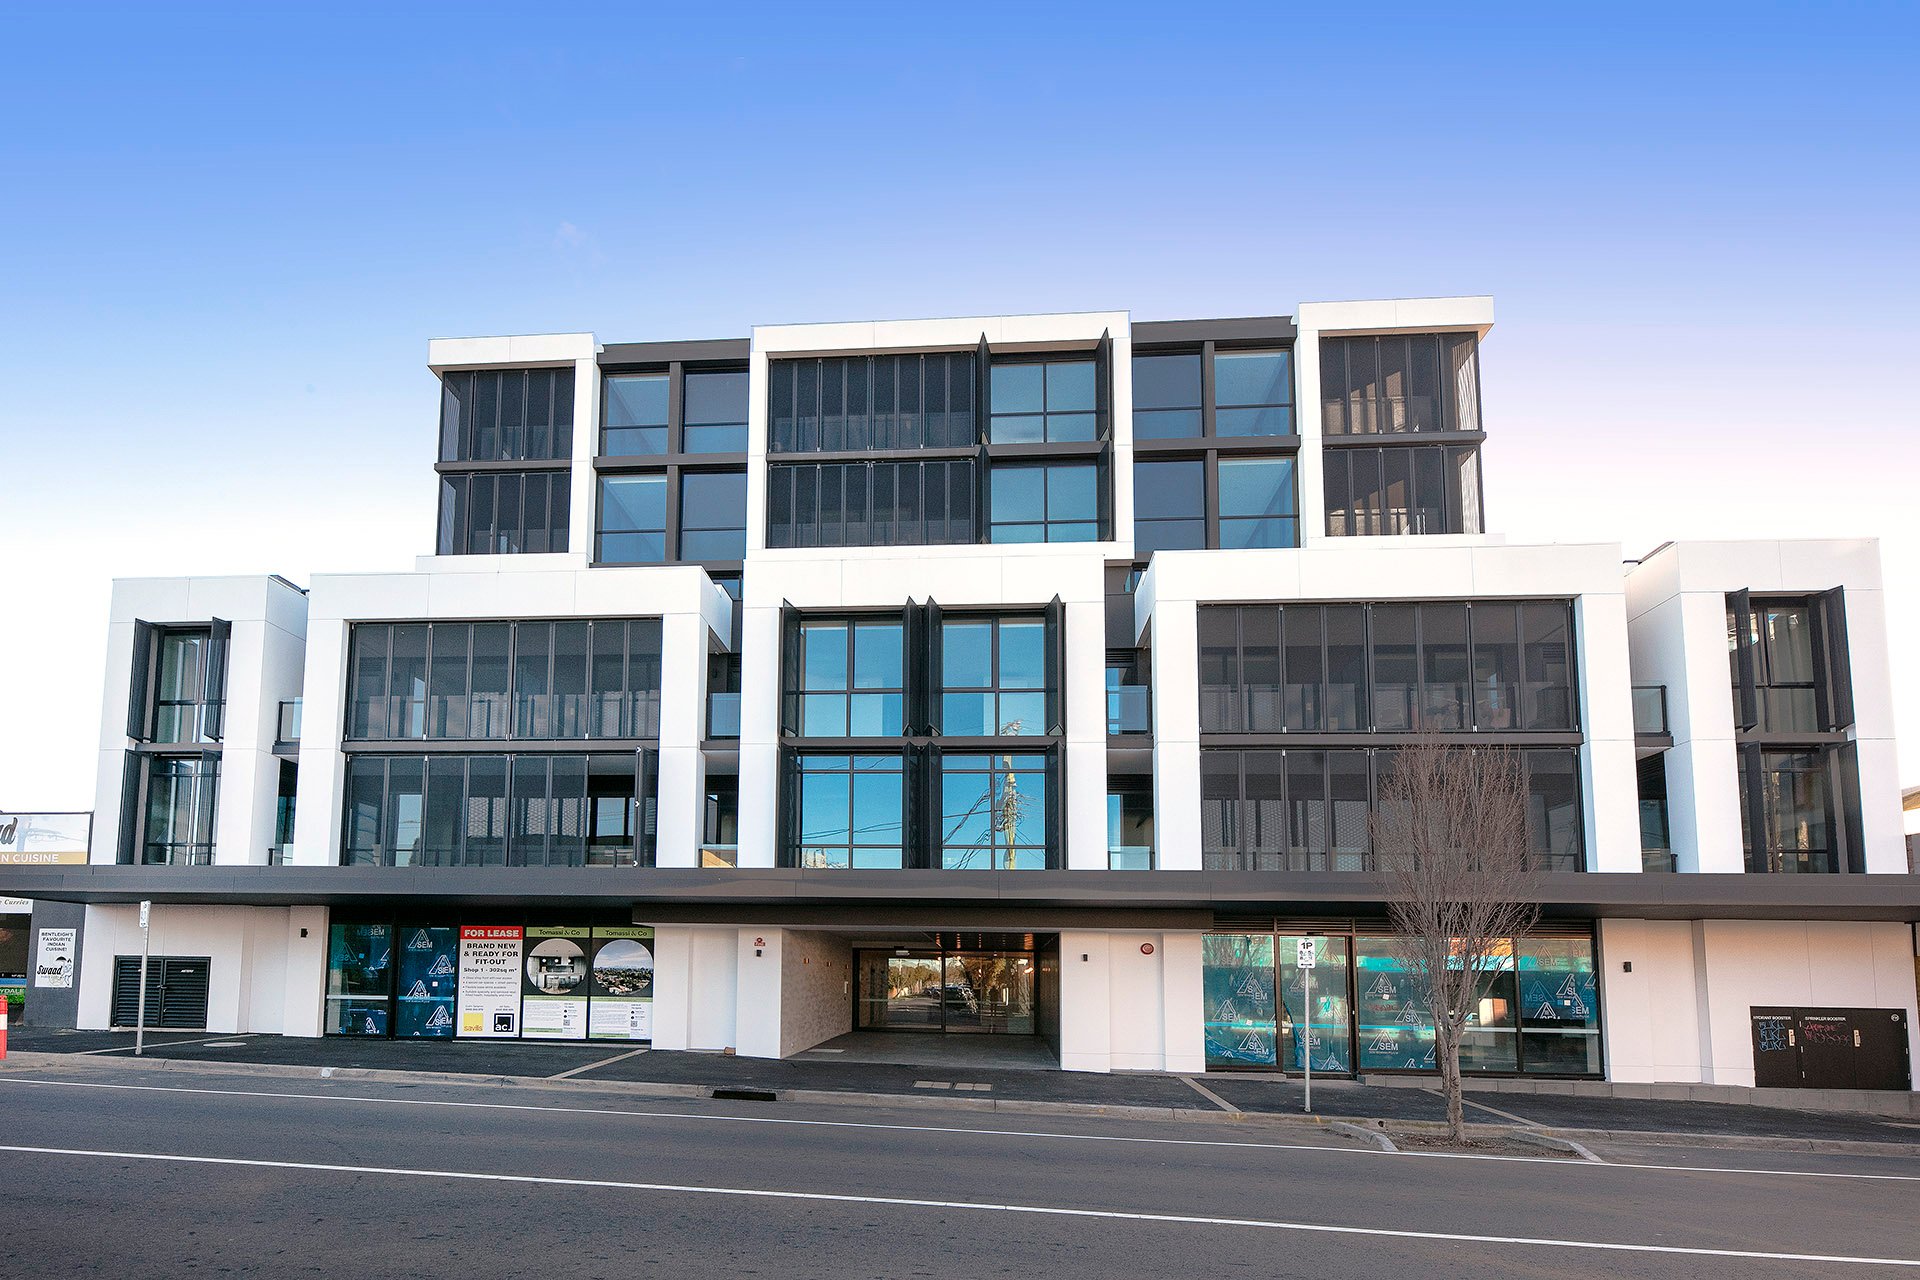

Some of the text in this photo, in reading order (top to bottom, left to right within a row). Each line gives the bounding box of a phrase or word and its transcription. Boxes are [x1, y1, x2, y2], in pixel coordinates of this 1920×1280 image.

[13, 854, 59, 863] CUISINE
[37, 964, 63, 975] Swaad
[1378, 986, 1397, 994] SEM
